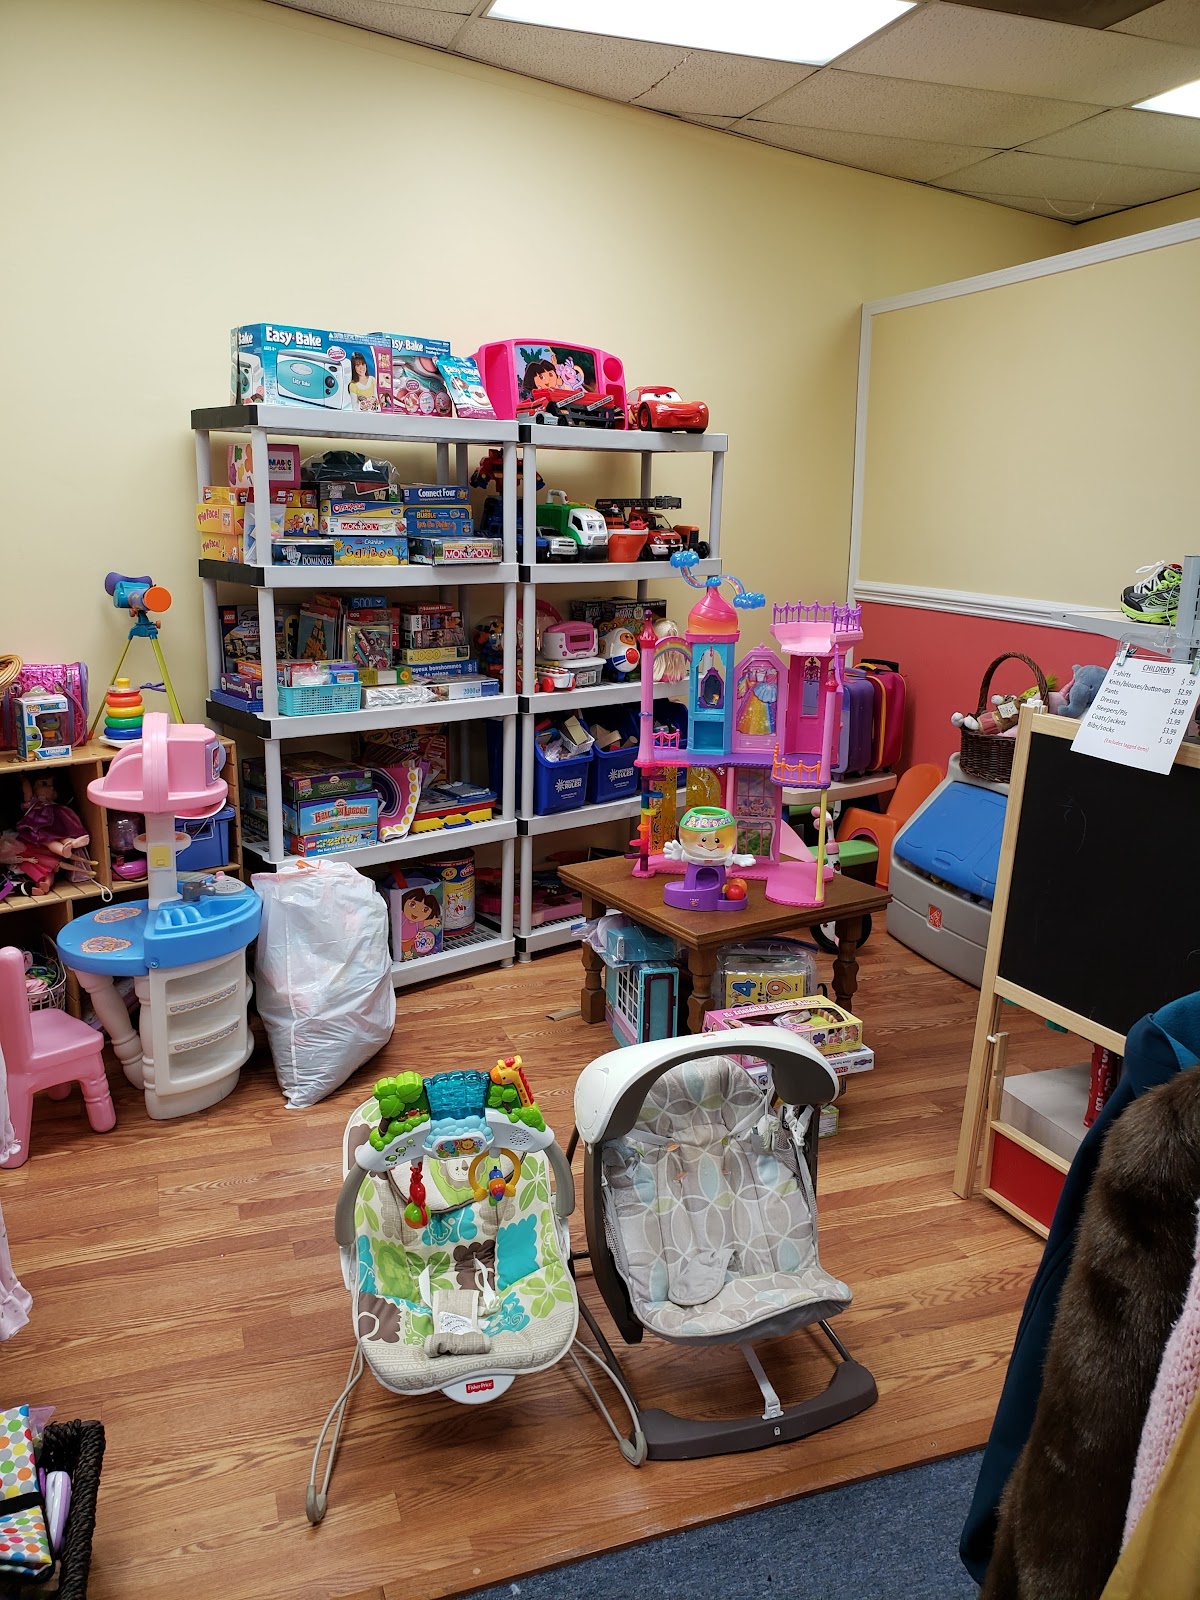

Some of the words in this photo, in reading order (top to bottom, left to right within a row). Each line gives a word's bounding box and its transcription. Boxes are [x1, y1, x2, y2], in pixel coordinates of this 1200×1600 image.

[418, 489, 442, 497] Connect
[442, 488, 456, 497] Four
[341, 522, 379, 530] MONOPOLY
[445, 549, 492, 559] MONOPOLY
[302, 557, 333, 566] DOMINOES
[413, 649, 441, 661] 1000
[1142, 664, 1176, 674] CHILDREN'S
[1113, 670, 1132, 678] T-shirts
[1100, 696, 1120, 705] Dresses
[1170, 708, 1184, 716] $4.99
[1173, 698, 1188, 706] $3.99
[1091, 713, 1126, 726] Coats/jackets
[1166, 717, 1181, 725] $1.99
[1087, 722, 1115, 733] Bibs/socks
